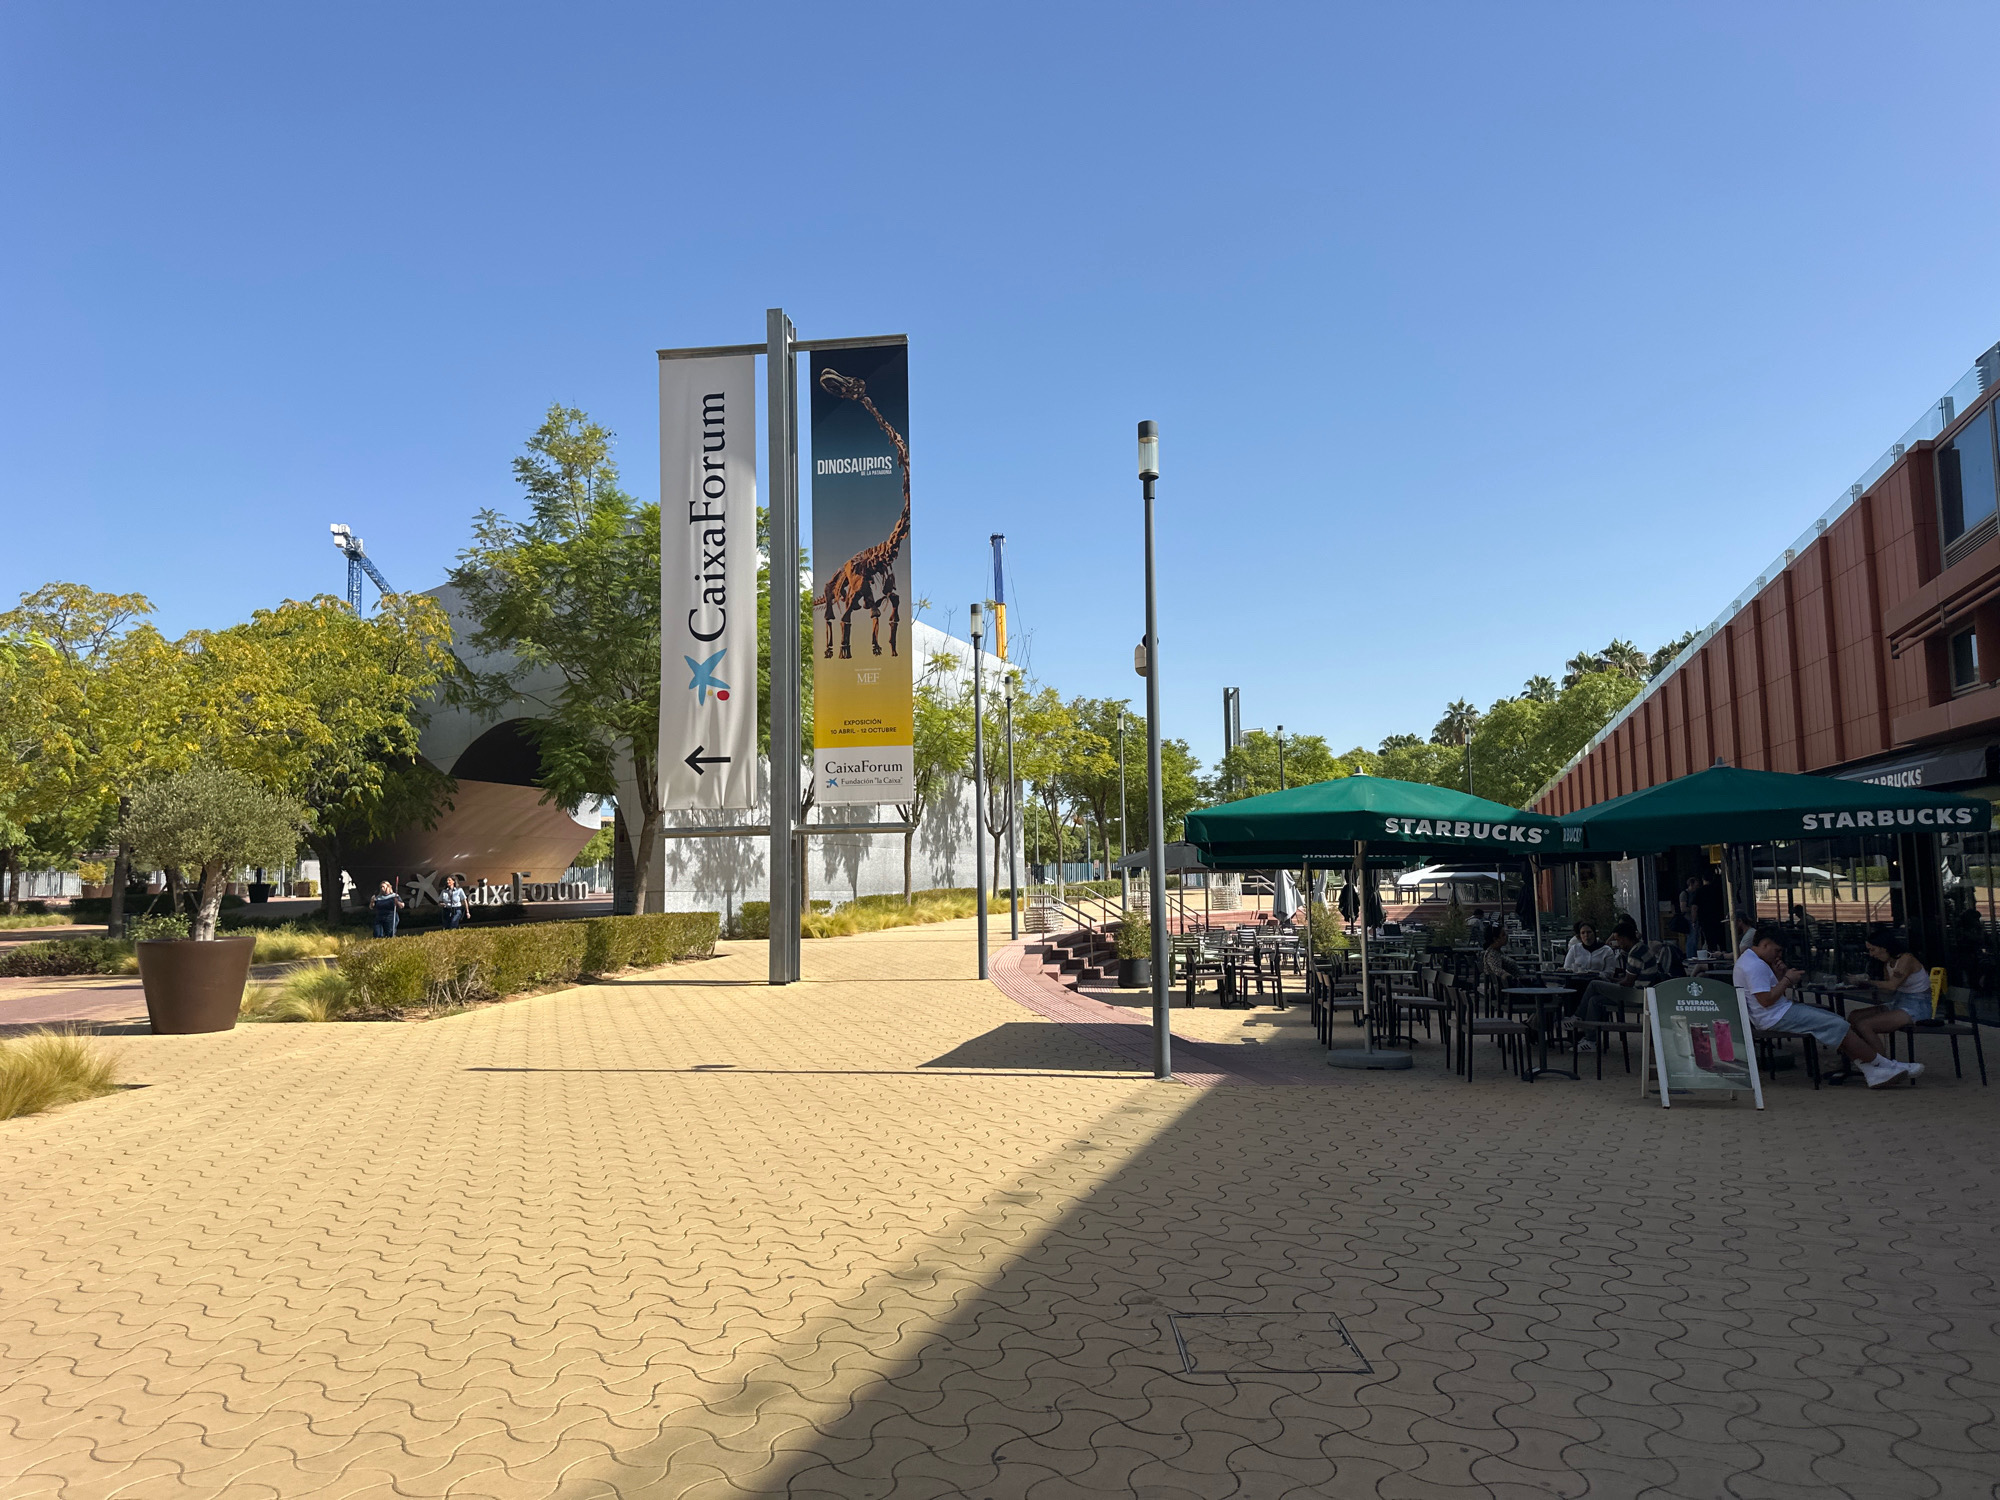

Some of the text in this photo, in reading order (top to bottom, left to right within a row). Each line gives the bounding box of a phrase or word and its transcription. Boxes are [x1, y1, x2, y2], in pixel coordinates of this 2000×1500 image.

[817, 456, 892, 475] DINOSAURIOS
[688, 391, 726, 642] CaixaForum
[857, 673, 880, 683] MEF
[825, 760, 903, 774] CaixaForum
[841, 777, 874, 785] Fundación
